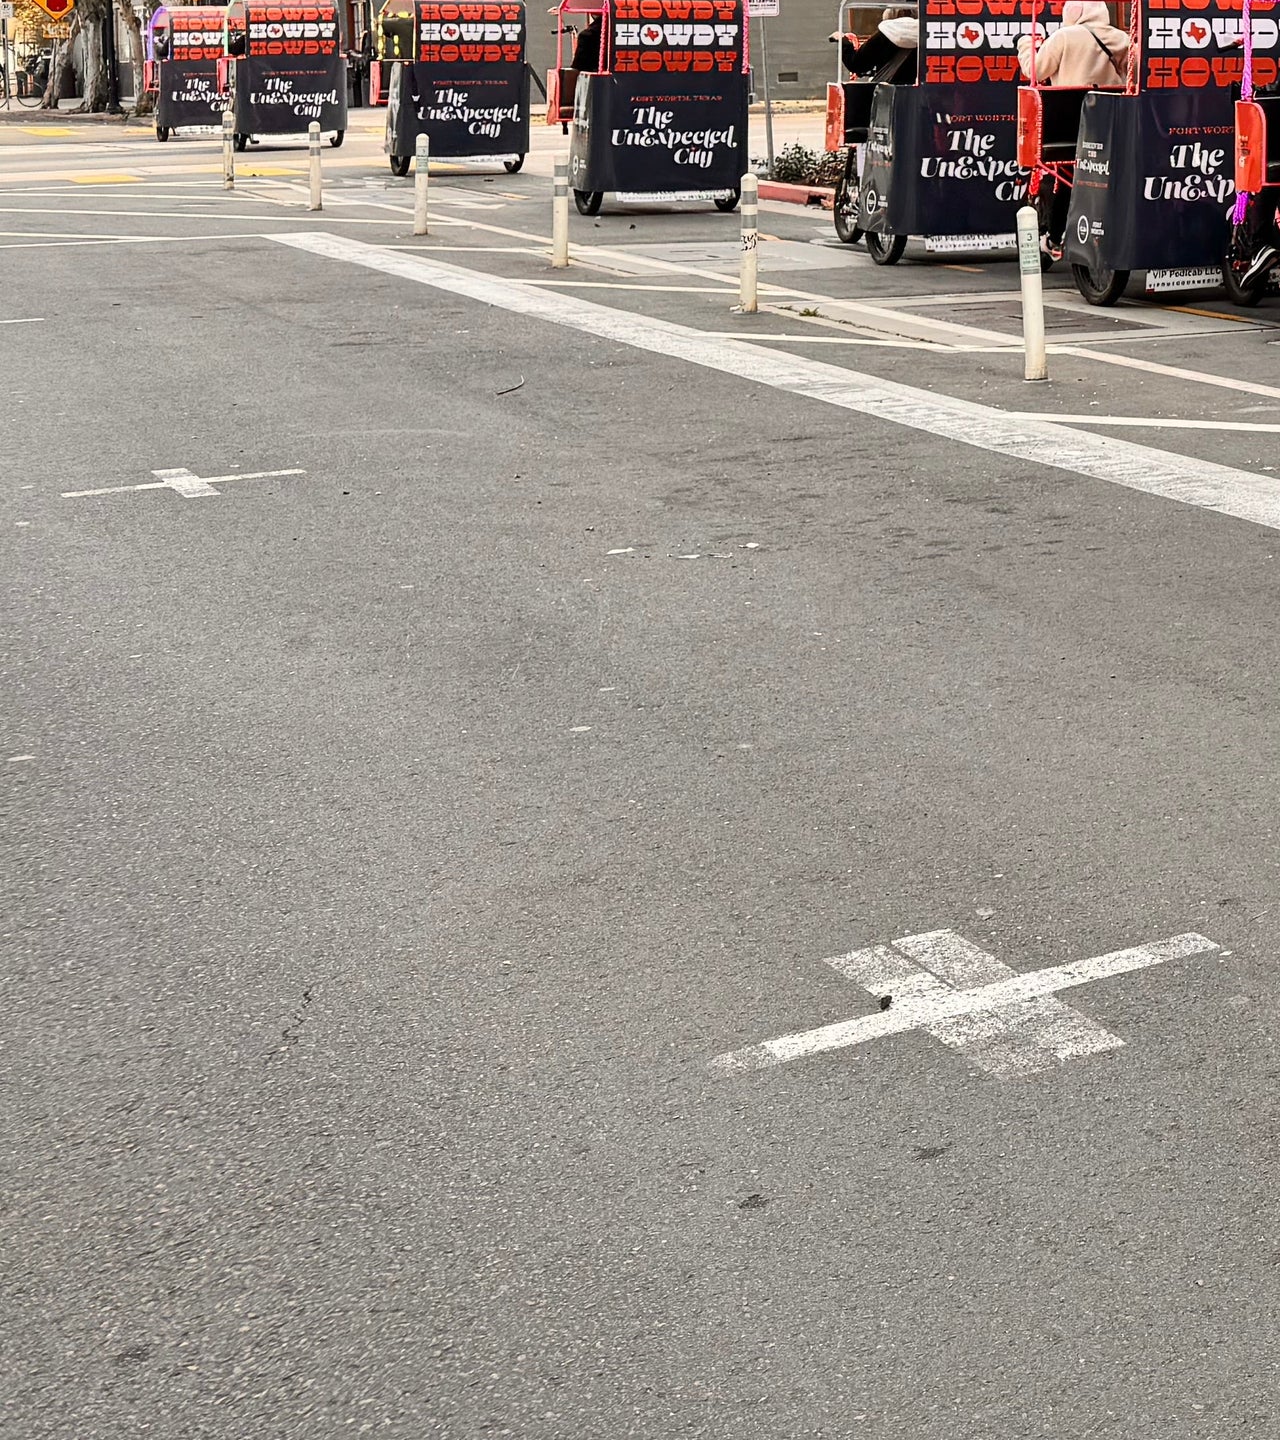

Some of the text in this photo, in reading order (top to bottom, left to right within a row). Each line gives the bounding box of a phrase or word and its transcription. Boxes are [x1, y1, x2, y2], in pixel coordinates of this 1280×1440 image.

[249, 7, 335, 21] HOWDY
[419, 3, 521, 21] HOWDY
[173, 32, 225, 46] HOW
[250, 23, 336, 39] HOWDY
[420, 23, 522, 42] HOWDY
[614, 23, 739, 47] HOWDY
[926, 21, 1063, 50] HOWD
[173, 47, 225, 60] HOW
[250, 40, 336, 55] HOWDY
[420, 44, 521, 62] HOWDY
[613, 50, 738, 73] HOWDY
[925, 55, 1020, 84] HOW
[184, 78, 211, 95] The
[264, 77, 293, 94] The
[172, 91, 231, 104] UnExpec
[435, 87, 469, 108] The
[293, 103, 322, 118] City
[632, 106, 674, 130] The
[946, 114, 973, 123] ORT
[468, 120, 501, 138] City
[611, 125, 739, 150] UnExpected
[1169, 125, 1236, 136] FORT WORT
[946, 128, 996, 158] The
[673, 146, 714, 169] City
[1169, 142, 1225, 176] The
[920, 155, 1032, 182] UnExpe
[995, 178, 1028, 202] Ci
[1144, 174, 1235, 205] UnExp
[1026, 232, 1033, 242] 3
[1152, 270, 1167, 279] VIP
